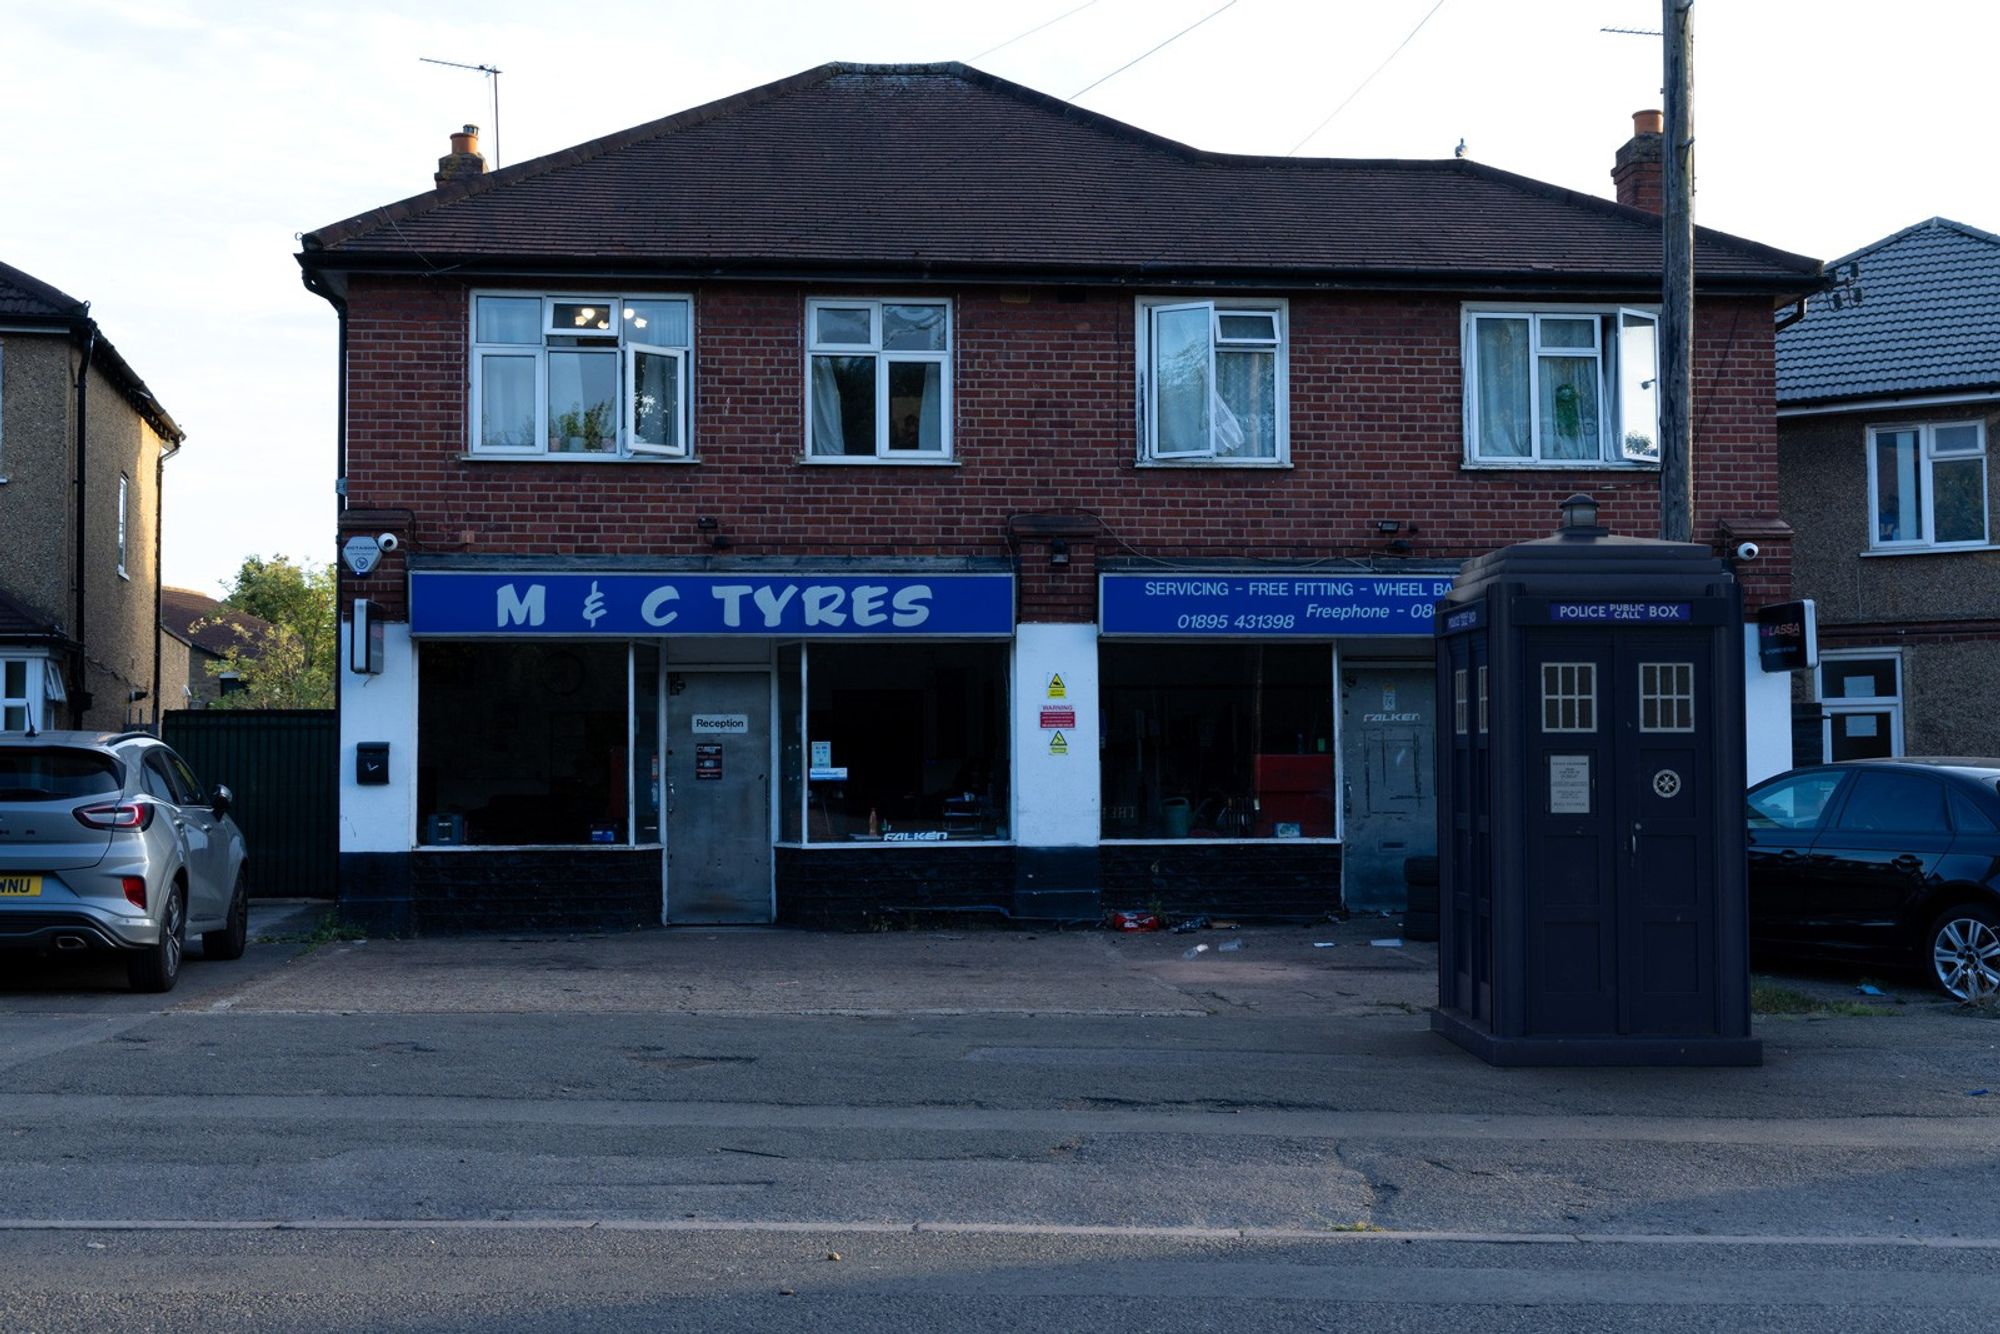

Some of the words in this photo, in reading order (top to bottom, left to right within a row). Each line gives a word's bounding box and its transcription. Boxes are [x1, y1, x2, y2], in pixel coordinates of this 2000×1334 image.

[1145, 581, 1229, 596] SERVICING
[1248, 582, 1289, 596] FREE
[1294, 582, 1354, 596] FITTING
[1373, 582, 1428, 596] WHEEL
[497, 583, 546, 627] M
[582, 580, 607, 629] &
[641, 585, 680, 627] C
[711, 584, 932, 627] TYRES
[1609, 603, 1645, 611] PUBLIC
[1306, 603, 1390, 621] Freephone
[1410, 604, 1436, 618] 08
[1559, 605, 1606, 618] POLICE
[1614, 611, 1641, 619] CALL
[1648, 605, 1680, 618] BOX
[1177, 614, 1229, 629] 01895
[1234, 614, 1295, 629] 431398
[1768, 622, 1801, 637] LASSA
[696, 718, 744, 728] Reception
[883, 830, 948, 841] FALKEN
